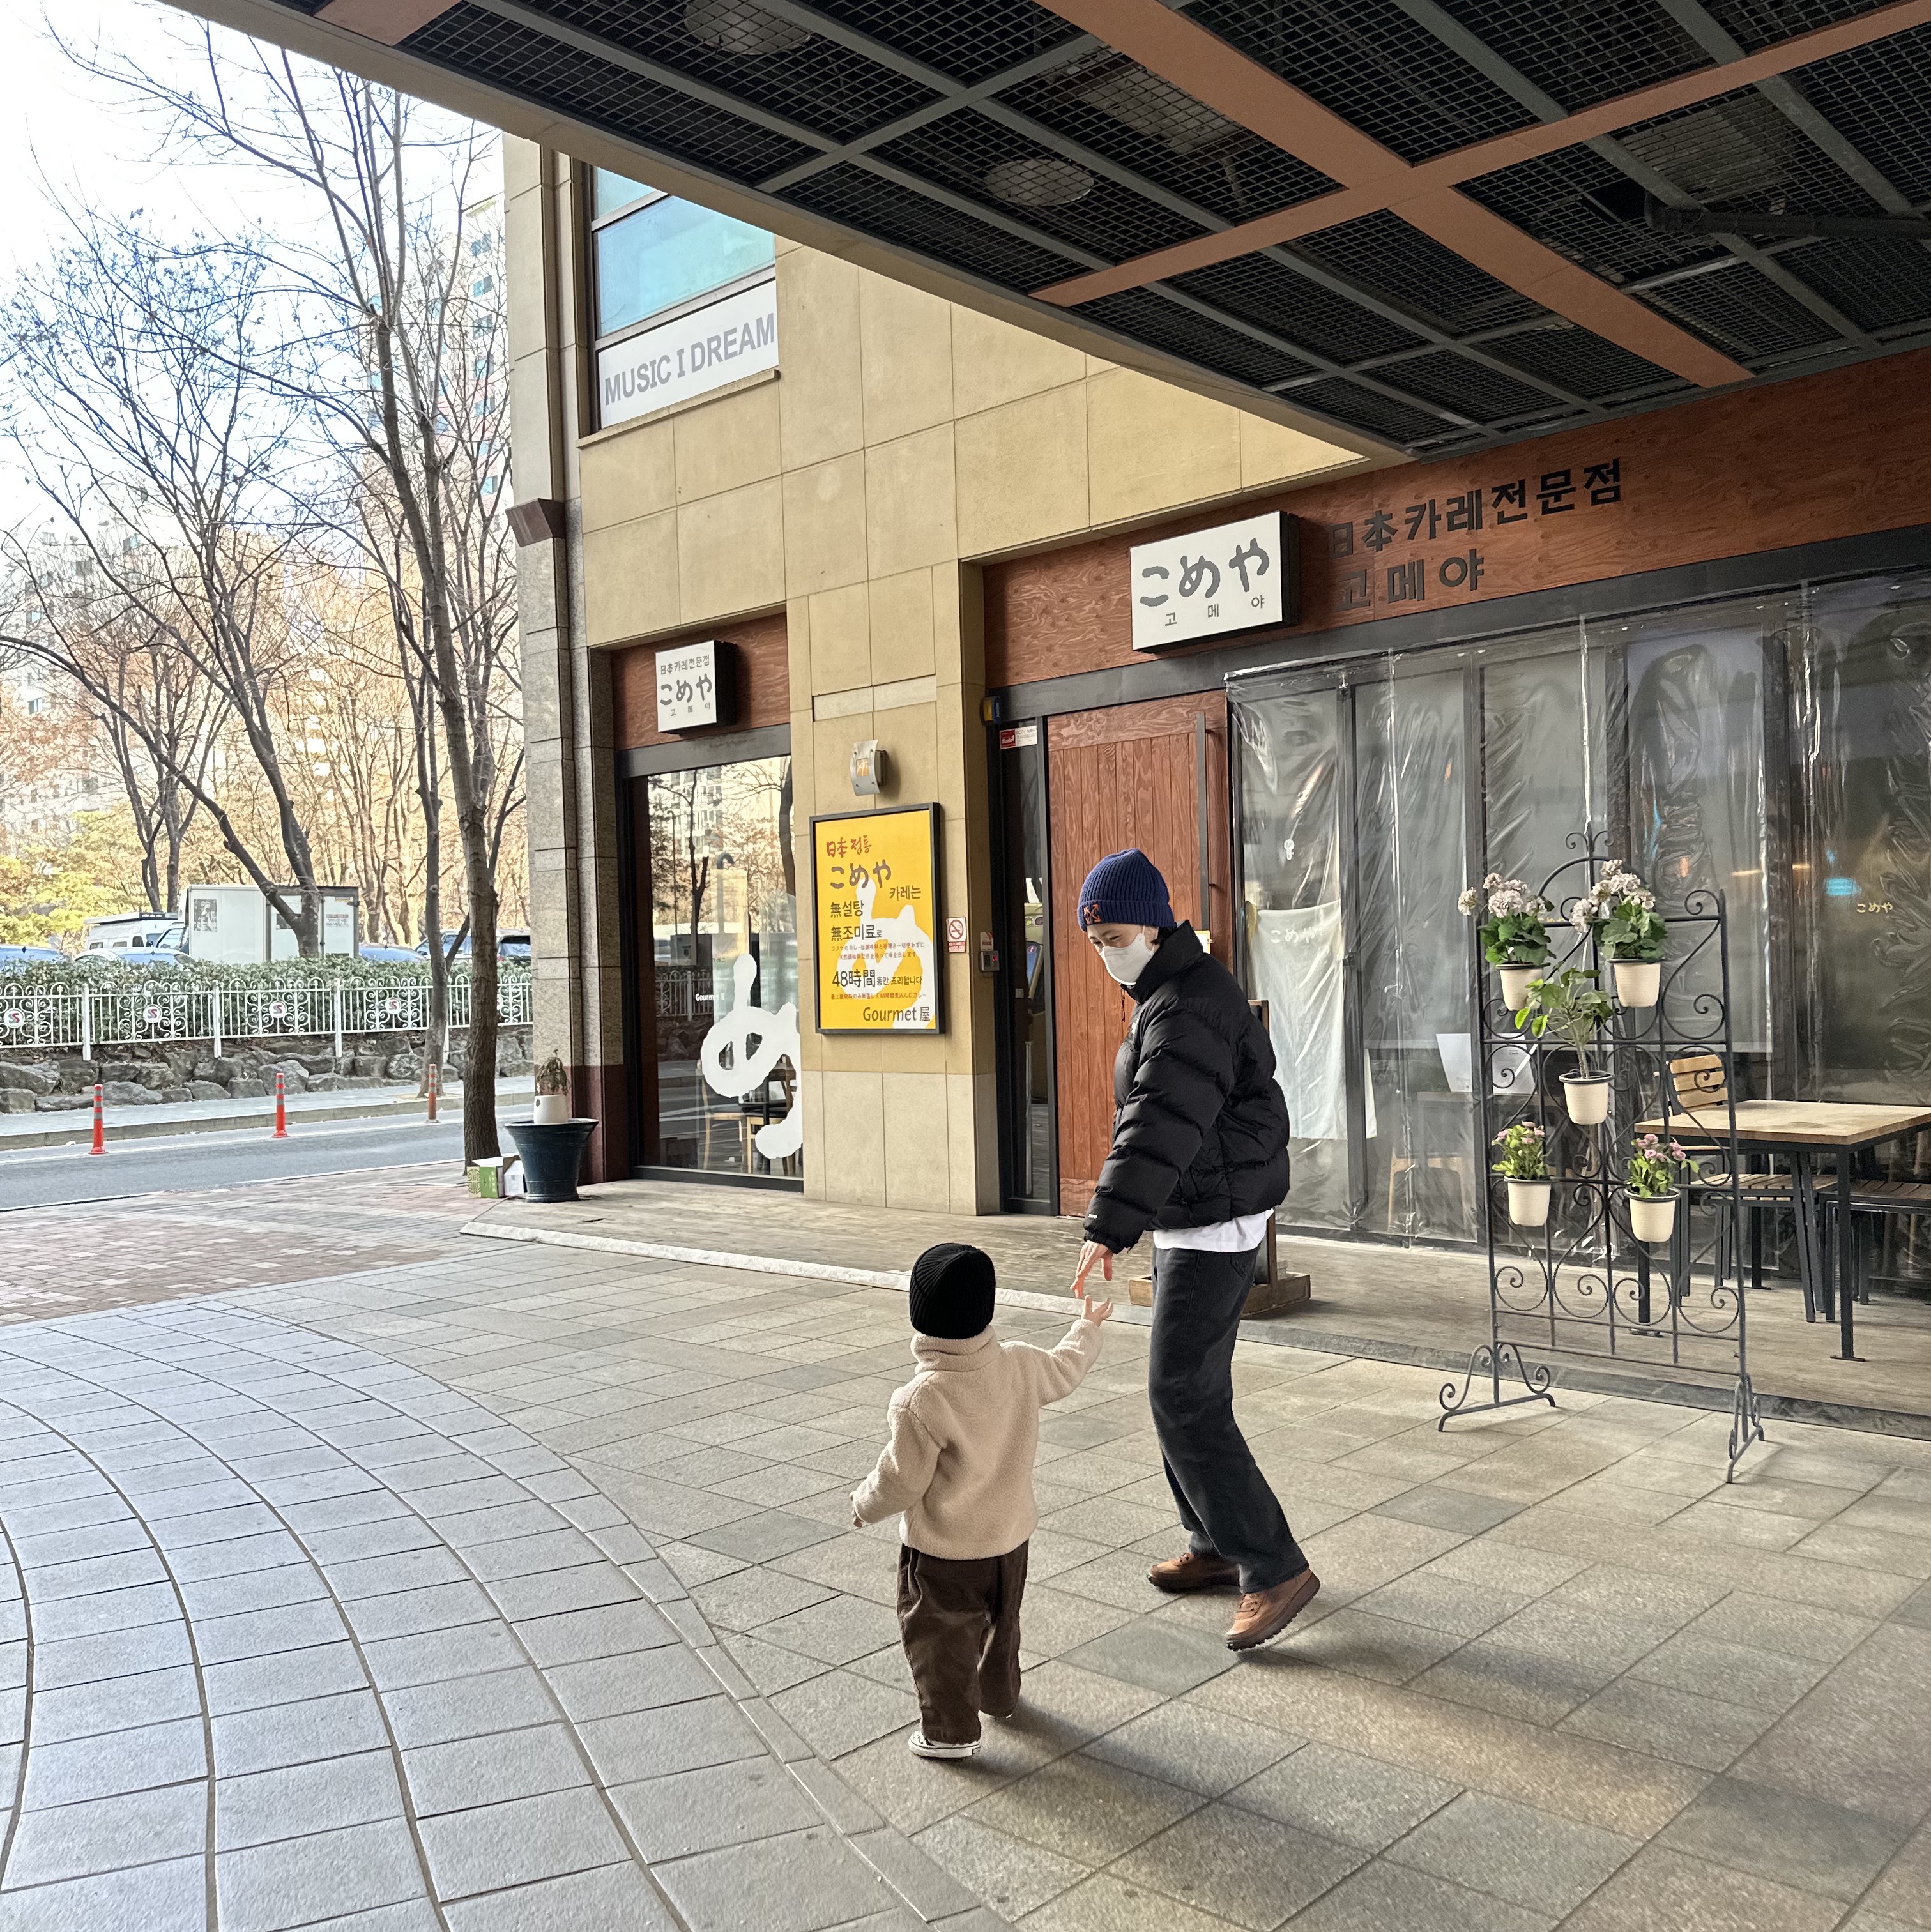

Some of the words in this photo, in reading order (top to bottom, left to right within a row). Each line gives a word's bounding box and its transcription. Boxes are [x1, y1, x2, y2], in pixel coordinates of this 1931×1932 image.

[605, 354, 671, 406] MUSIC
[677, 348, 685, 379] I
[691, 312, 775, 374] DREAM
[1329, 457, 1621, 559] 日本카레전문점
[1140, 538, 1270, 607] こめや
[1332, 548, 1485, 613] 고메야
[660, 654, 710, 675] 日本카레전문점
[660, 673, 712, 706] こめや
[826, 837, 848, 858] 日本
[851, 835, 872, 855] 정통
[830, 859, 892, 889] こめや
[889, 885, 922, 901] 카레는
[830, 900, 864, 918] 無설탕
[1856, 902, 1893, 913] こめや
[831, 924, 883, 942] 無조미료로
[862, 1007, 917, 1021] Gourmet
[920, 1006, 931, 1022] 屋
